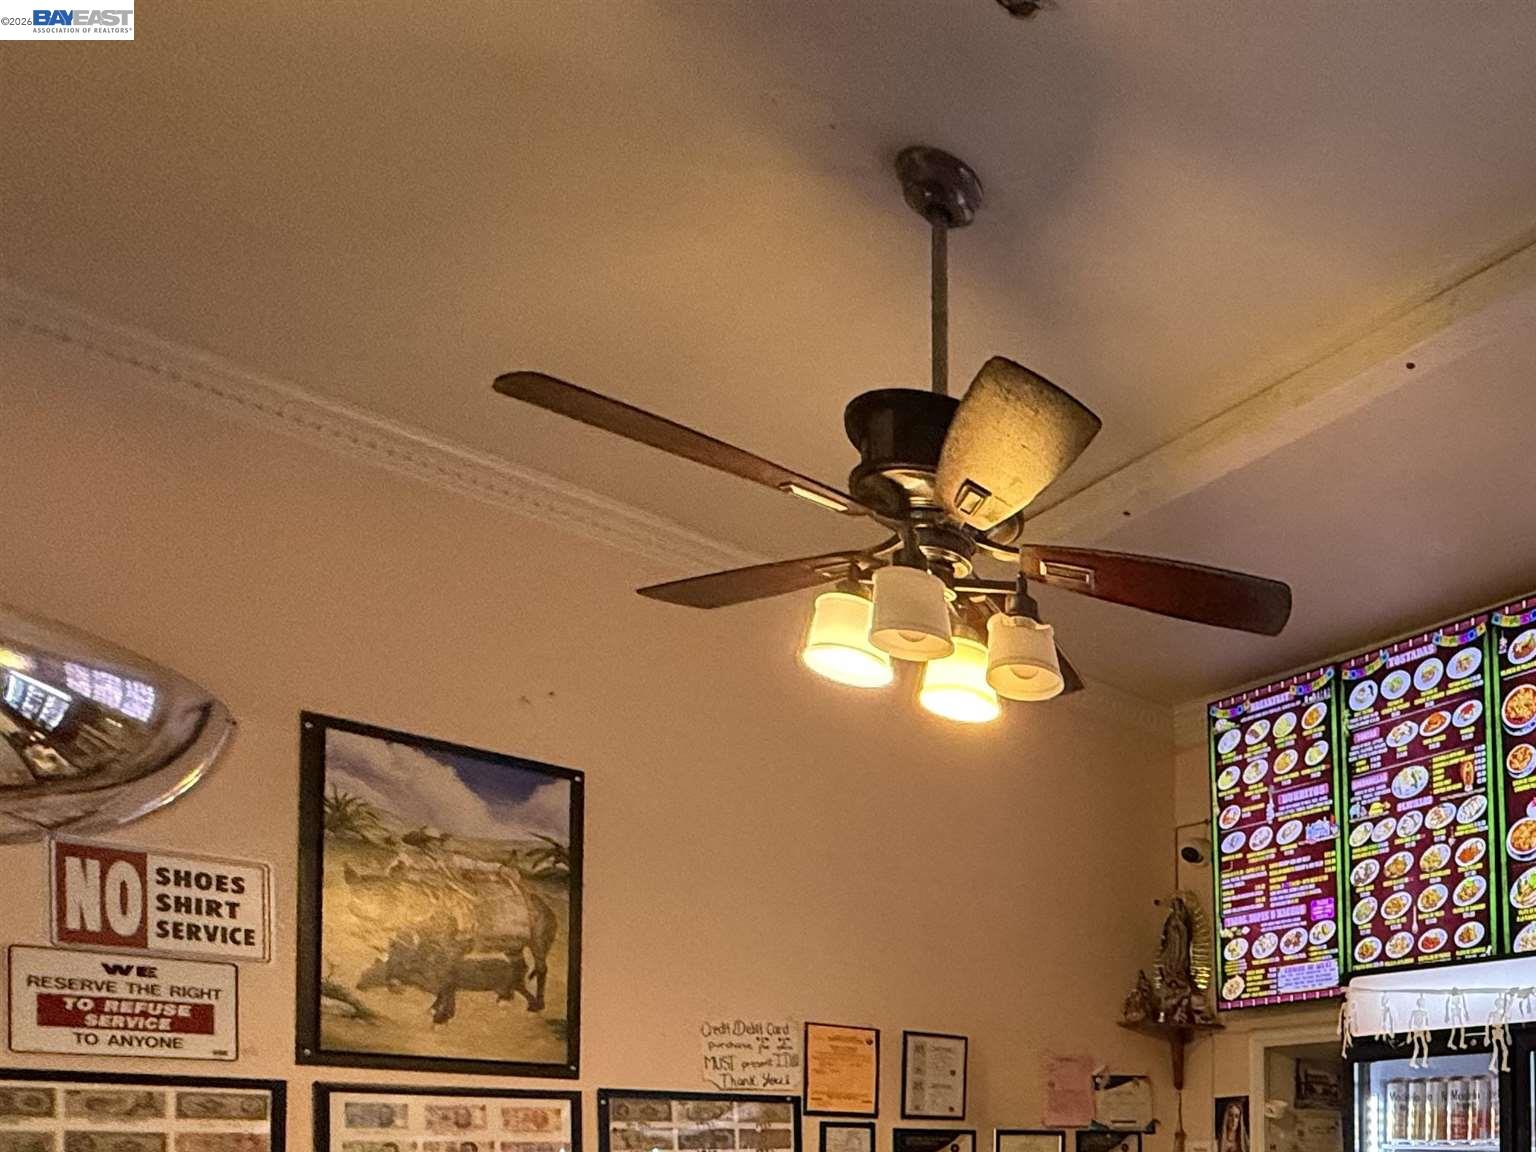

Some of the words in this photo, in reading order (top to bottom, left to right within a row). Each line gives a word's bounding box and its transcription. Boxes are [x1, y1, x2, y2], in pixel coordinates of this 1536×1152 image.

[155, 867, 245, 894] SHOES
[65, 856, 143, 937] NO
[155, 893, 240, 919] SHIRT
[155, 920, 255, 946] SERVICE
[101, 963, 158, 978] WE
[26, 974, 117, 994] RESERVE
[128, 982, 161, 997] THE
[169, 985, 222, 1001] RIGHT
[63, 997, 95, 1011] TO
[104, 1000, 192, 1017] REFUSE
[84, 1014, 172, 1031] SERVICE
[73, 1032, 98, 1045] TO
[108, 1034, 184, 1049] ANYONE
